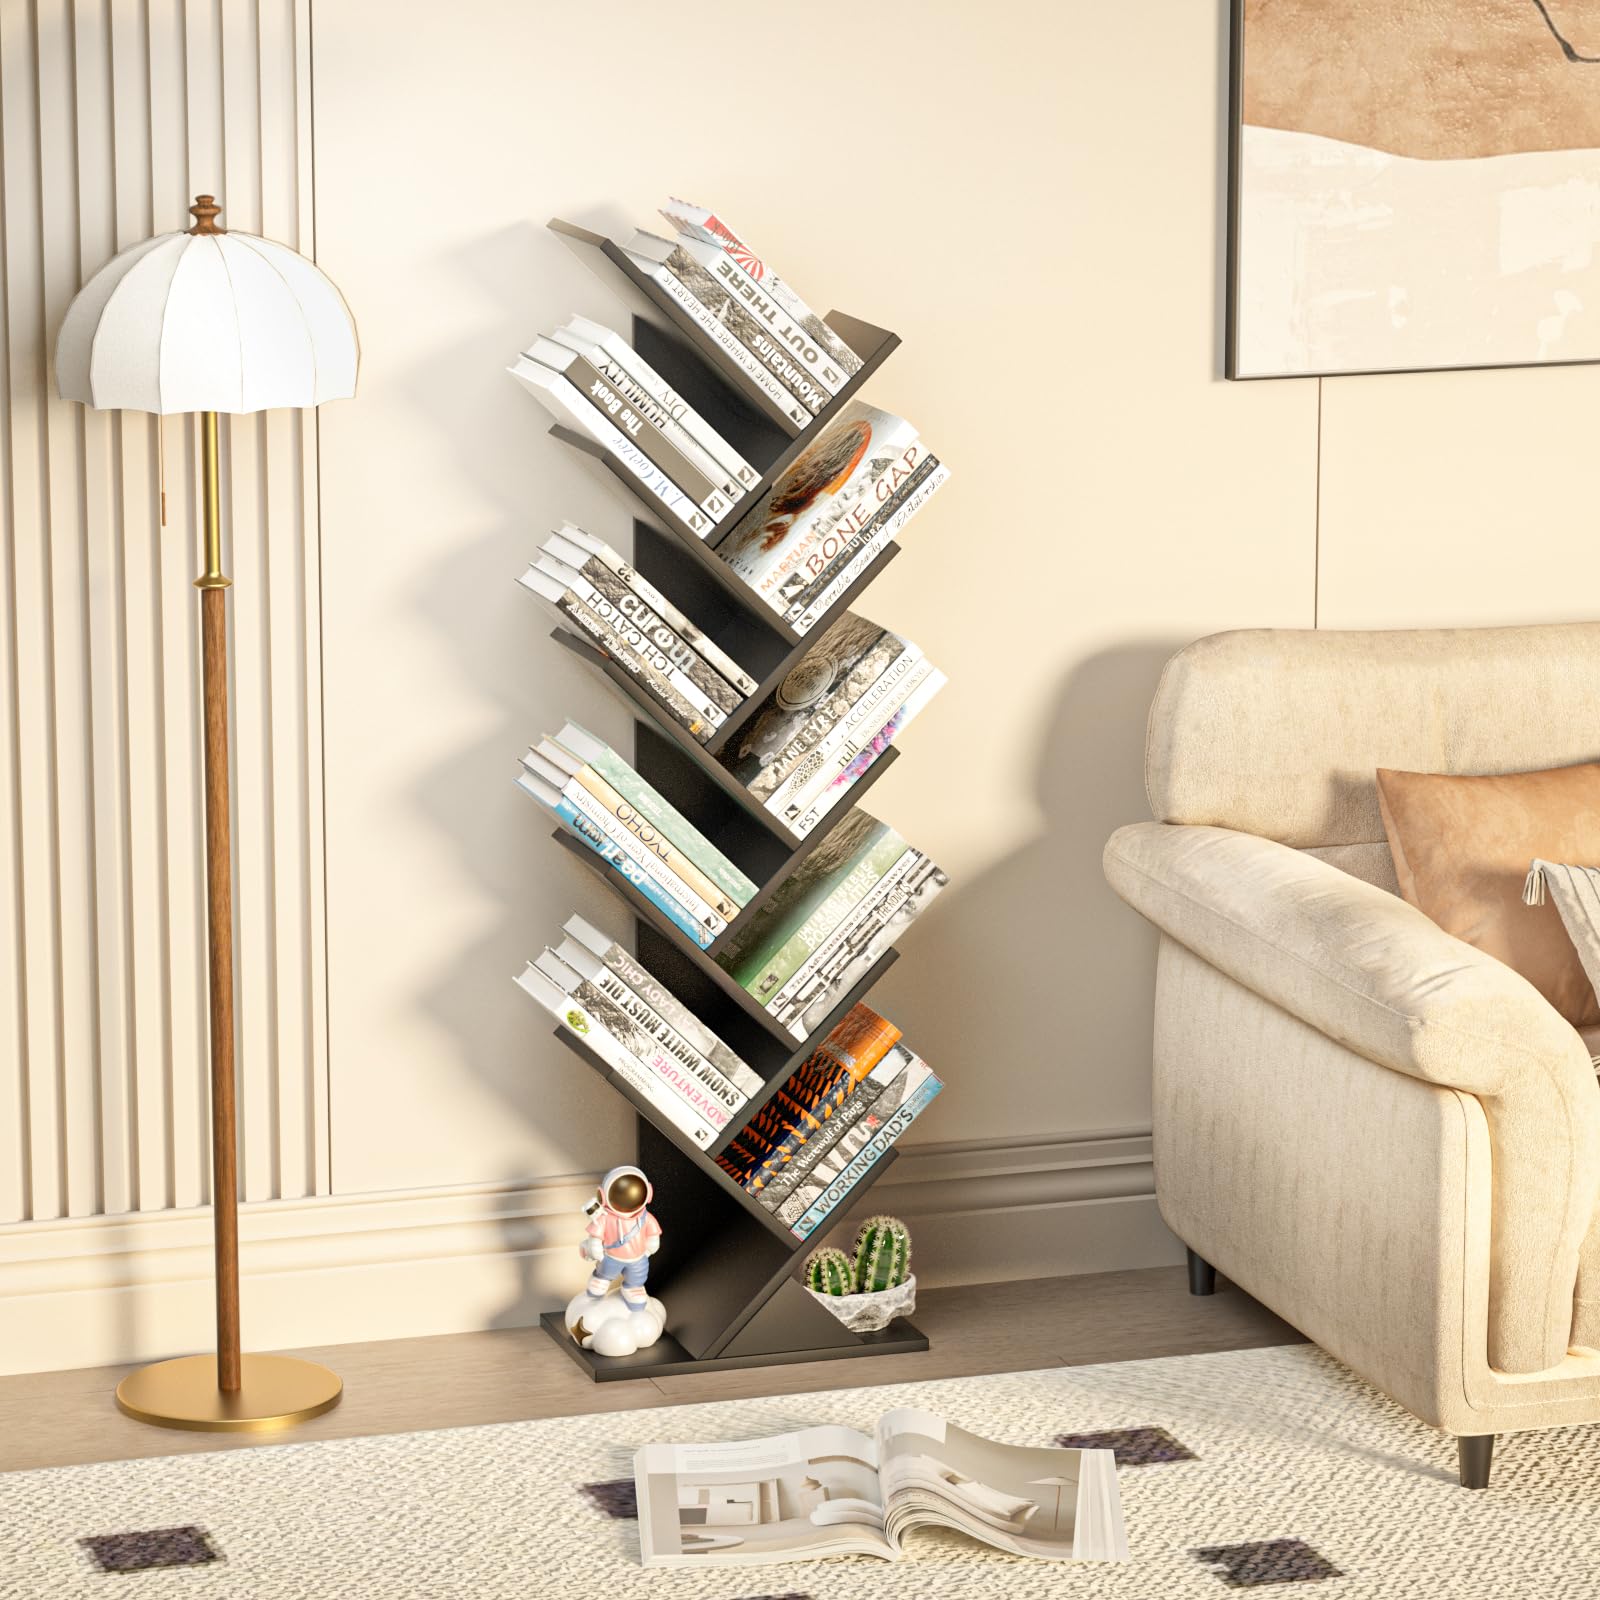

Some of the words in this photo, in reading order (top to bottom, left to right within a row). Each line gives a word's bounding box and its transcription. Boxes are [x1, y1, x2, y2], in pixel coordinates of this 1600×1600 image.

[662, 273, 676, 285] IS
[670, 282, 703, 314] HEART
[714, 258, 781, 325] THERE
[698, 310, 720, 333] THE
[715, 328, 750, 363] WHERE
[777, 322, 821, 366] OUT
[745, 360, 759, 373] IS
[749, 333, 824, 408] Mountains
[754, 369, 784, 400] HOME
[587, 377, 624, 414] Book
[598, 357, 671, 429] HUMILITY
[655, 387, 689, 421] Dry
[615, 407, 646, 436] The
[802, 501, 873, 577] BONE
[869, 444, 927, 506] GAP
[615, 561, 638, 583] 32
[759, 528, 818, 593] MARTIAN
[584, 589, 644, 647] CATCH
[842, 653, 914, 731] ACCELERATION
[769, 737, 809, 779] JANE
[802, 704, 840, 744] EYRE
[571, 787, 619, 835] Chemistry
[612, 801, 676, 861] TYCHO
[797, 805, 822, 832] FST
[613, 830, 629, 844] of
[624, 839, 651, 863] Year
[599, 842, 650, 886] pearl
[644, 857, 702, 913] International
[787, 969, 809, 992] The
[804, 918, 855, 973] Adventures
[850, 910, 863, 923] of
[857, 891, 879, 915] Tom
[875, 854, 914, 896] Sawyer
[597, 973, 627, 1000] DIE
[611, 954, 646, 986] CHIC
[619, 993, 663, 1034] MUST
[640, 982, 678, 1015] LADY
[655, 1026, 703, 1071] WHITE
[650, 1054, 728, 1126] ADVENTURE
[696, 1063, 742, 1108] SNOW
[779, 1165, 802, 1188] The
[796, 1128, 836, 1170] Werewolf
[830, 1116, 846, 1133] of
[840, 1097, 864, 1123] Paris
[813, 1146, 878, 1217] WORKING
[870, 1106, 915, 1153] DAD'S
